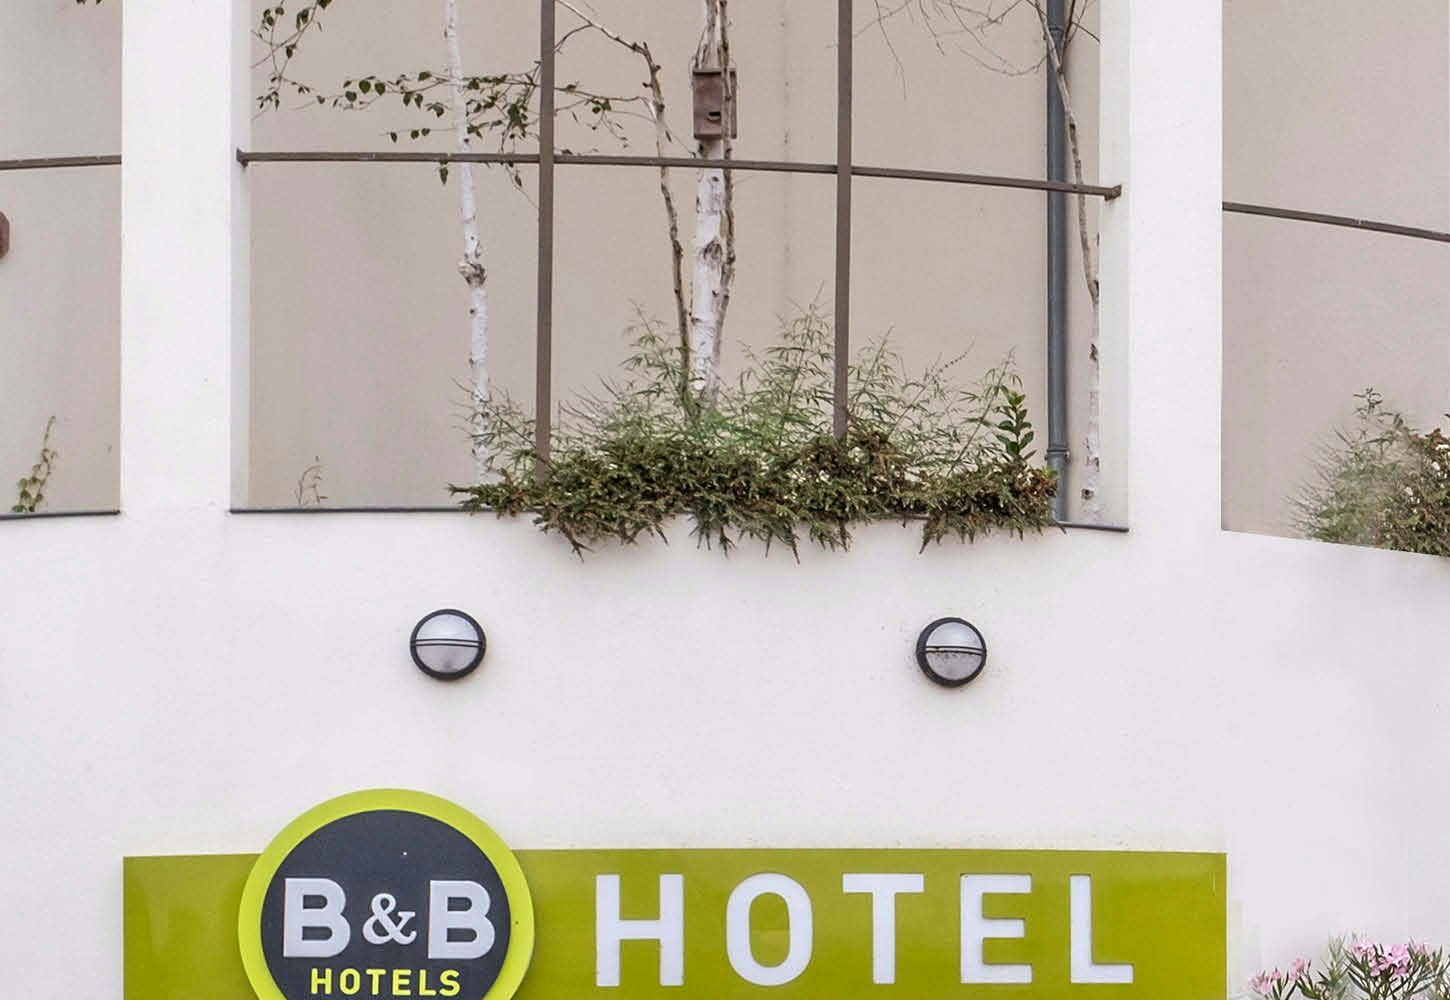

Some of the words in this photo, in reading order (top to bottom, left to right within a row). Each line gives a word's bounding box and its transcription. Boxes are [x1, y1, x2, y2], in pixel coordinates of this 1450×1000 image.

[283, 878, 496, 959] B&B
[595, 873, 1134, 986] HOTEL
[310, 968, 461, 996] HOTELS
